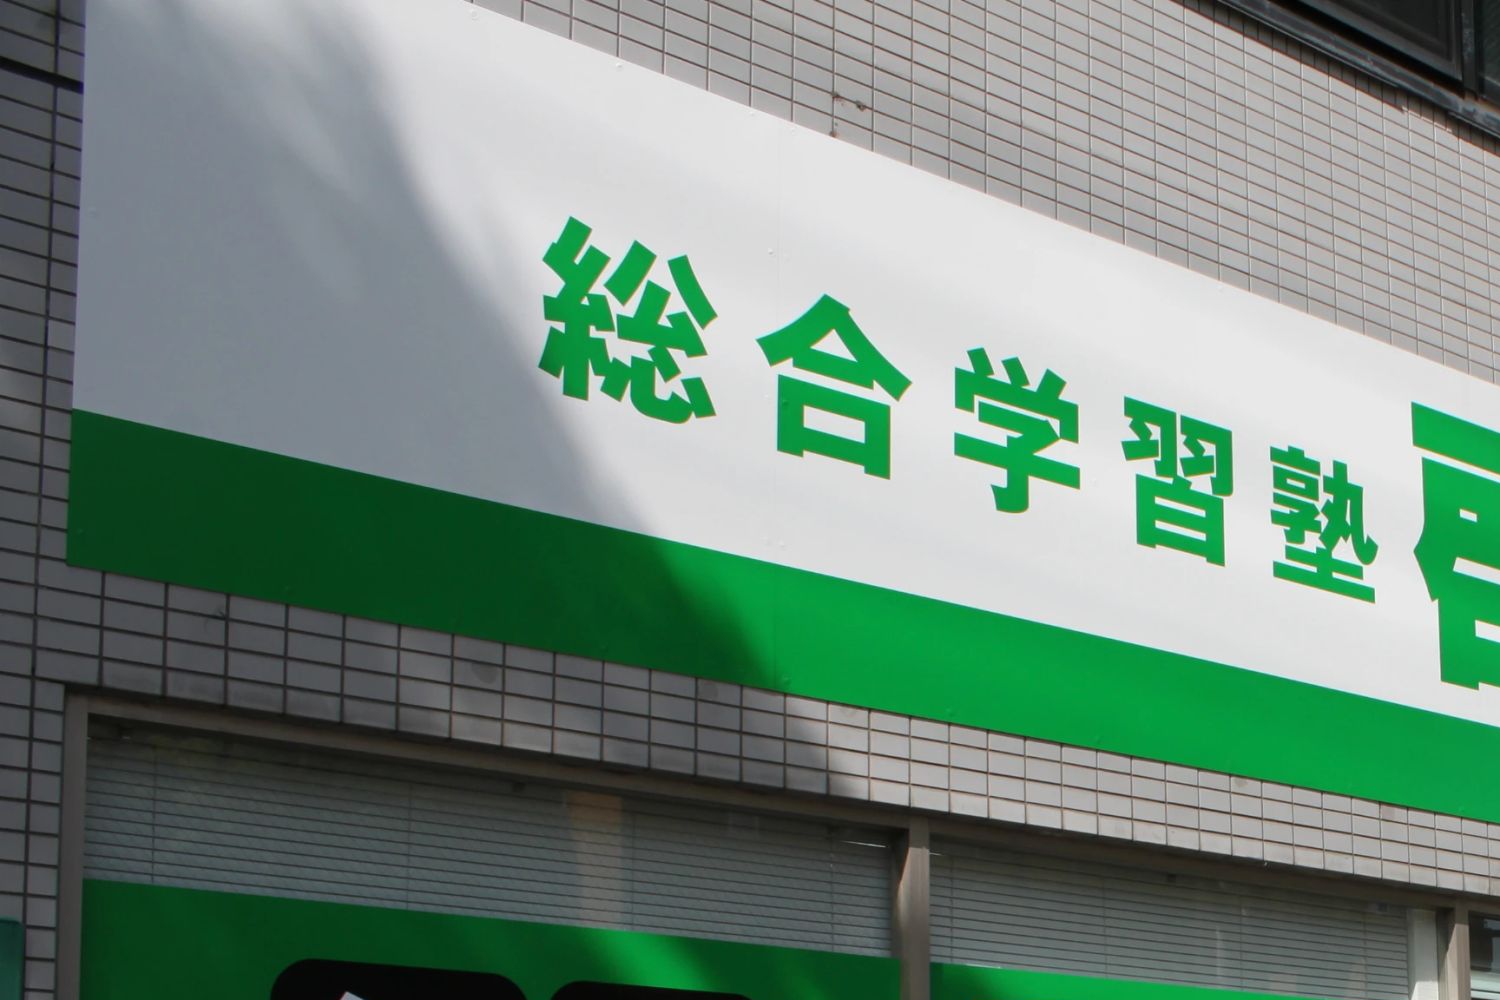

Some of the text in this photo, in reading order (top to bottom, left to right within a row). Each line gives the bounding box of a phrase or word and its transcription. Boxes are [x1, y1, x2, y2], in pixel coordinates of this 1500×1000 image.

[537, 216, 1379, 604] 総合学習塾
